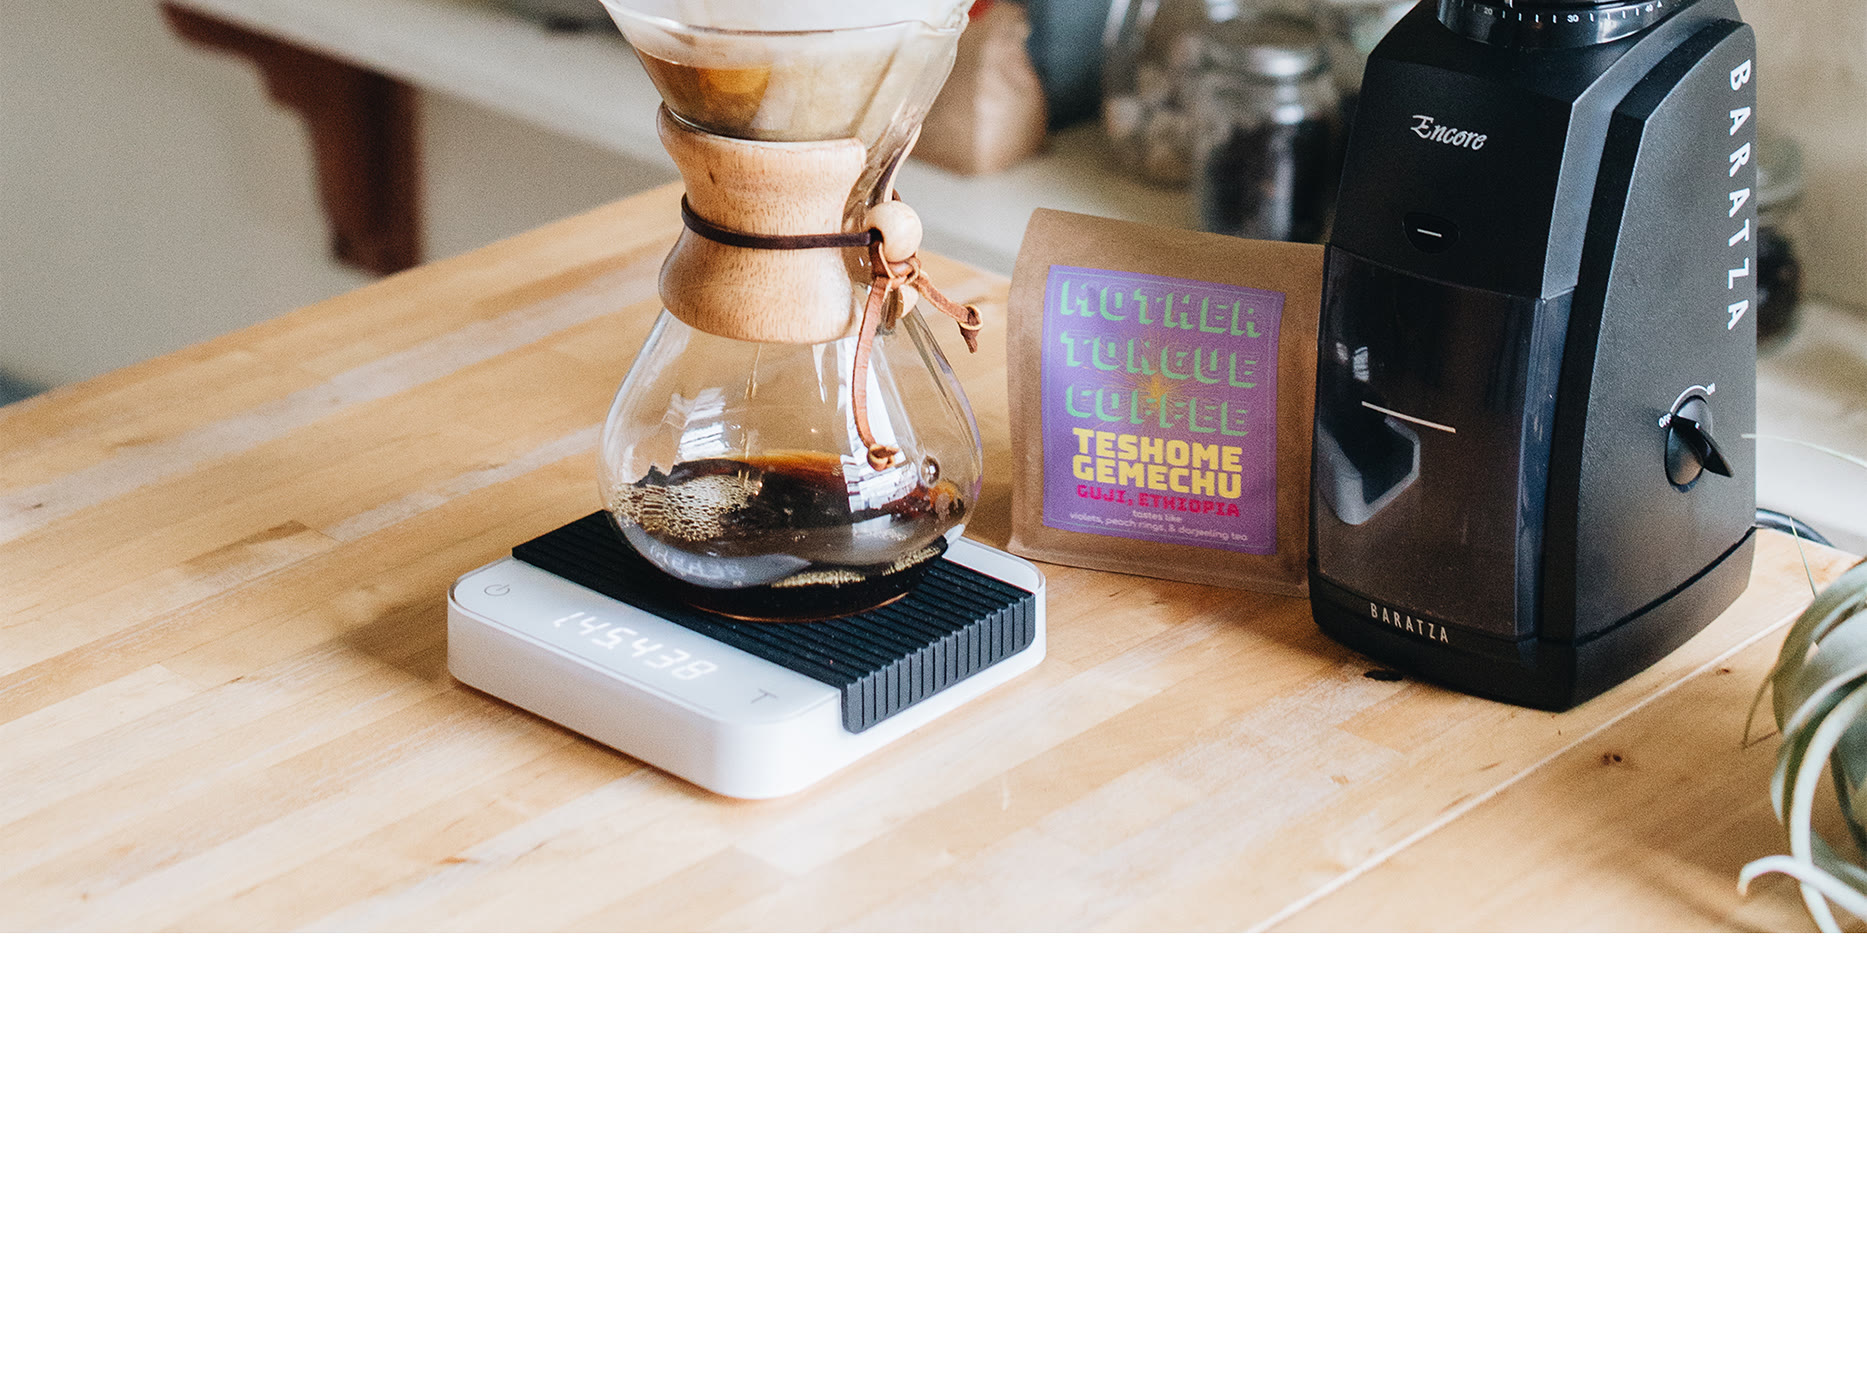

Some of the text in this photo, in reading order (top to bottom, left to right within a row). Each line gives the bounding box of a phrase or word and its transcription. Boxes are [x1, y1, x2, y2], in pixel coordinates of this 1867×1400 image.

[1567, 14, 1579, 23] 30
[1410, 114, 1487, 151] Encore
[1728, 59, 1751, 330] BARATZA
[1060, 279, 1263, 338] MOTHER
[1060, 330, 1257, 388] TONGUE
[1065, 384, 1249, 437] COFFEE
[1072, 427, 1243, 472] TESHOME
[1072, 454, 1242, 499] GEMECHU
[1077, 485, 1240, 517] GUJI, ETHIOPIA
[1132, 509, 1182, 523] tastes like
[1105, 516, 1136, 528] peach
[1168, 522, 1176, 533] &
[1178, 524, 1229, 541] darjeeling
[1231, 531, 1248, 541] tea
[1370, 602, 1449, 643] BARATZA
